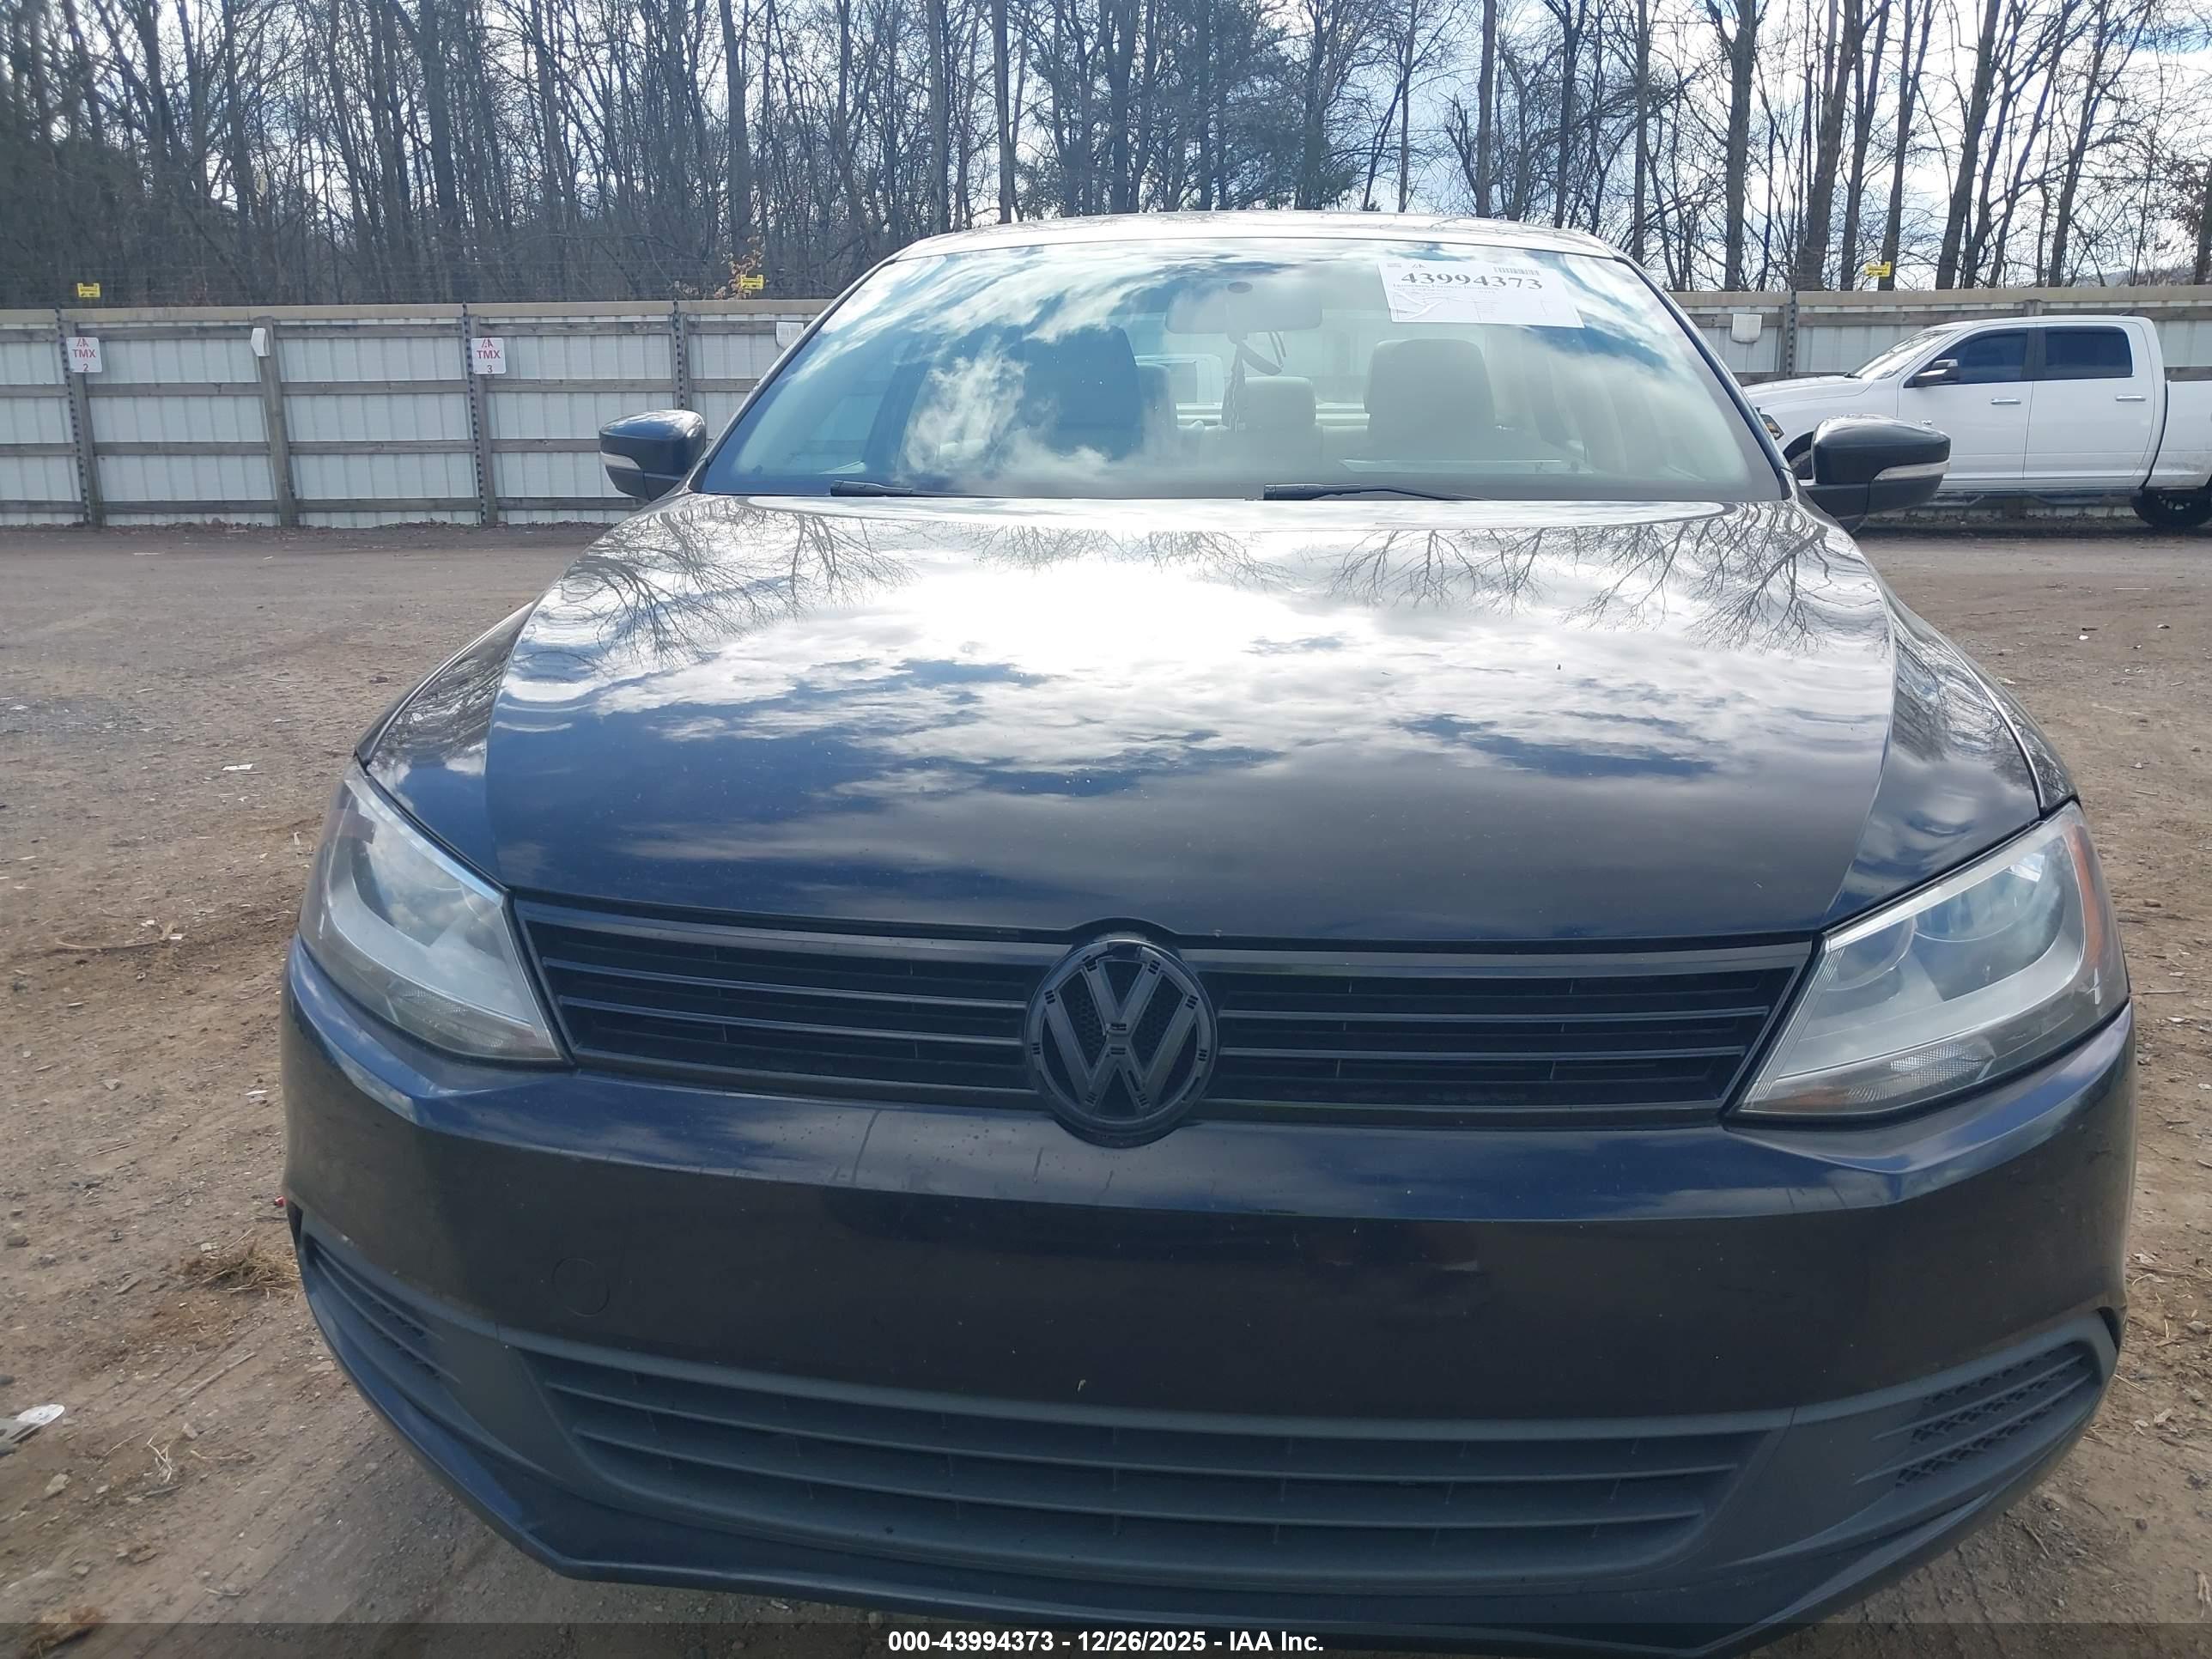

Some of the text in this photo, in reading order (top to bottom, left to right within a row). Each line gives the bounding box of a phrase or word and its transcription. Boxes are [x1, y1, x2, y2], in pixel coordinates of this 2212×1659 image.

[1401, 272, 1543, 290] 43994373
[72, 349, 96, 358] TMX
[477, 349, 501, 359] TMX
[82, 363, 89, 372] 2
[487, 364, 493, 374] 3
[1036, 951, 1201, 1121] VW
